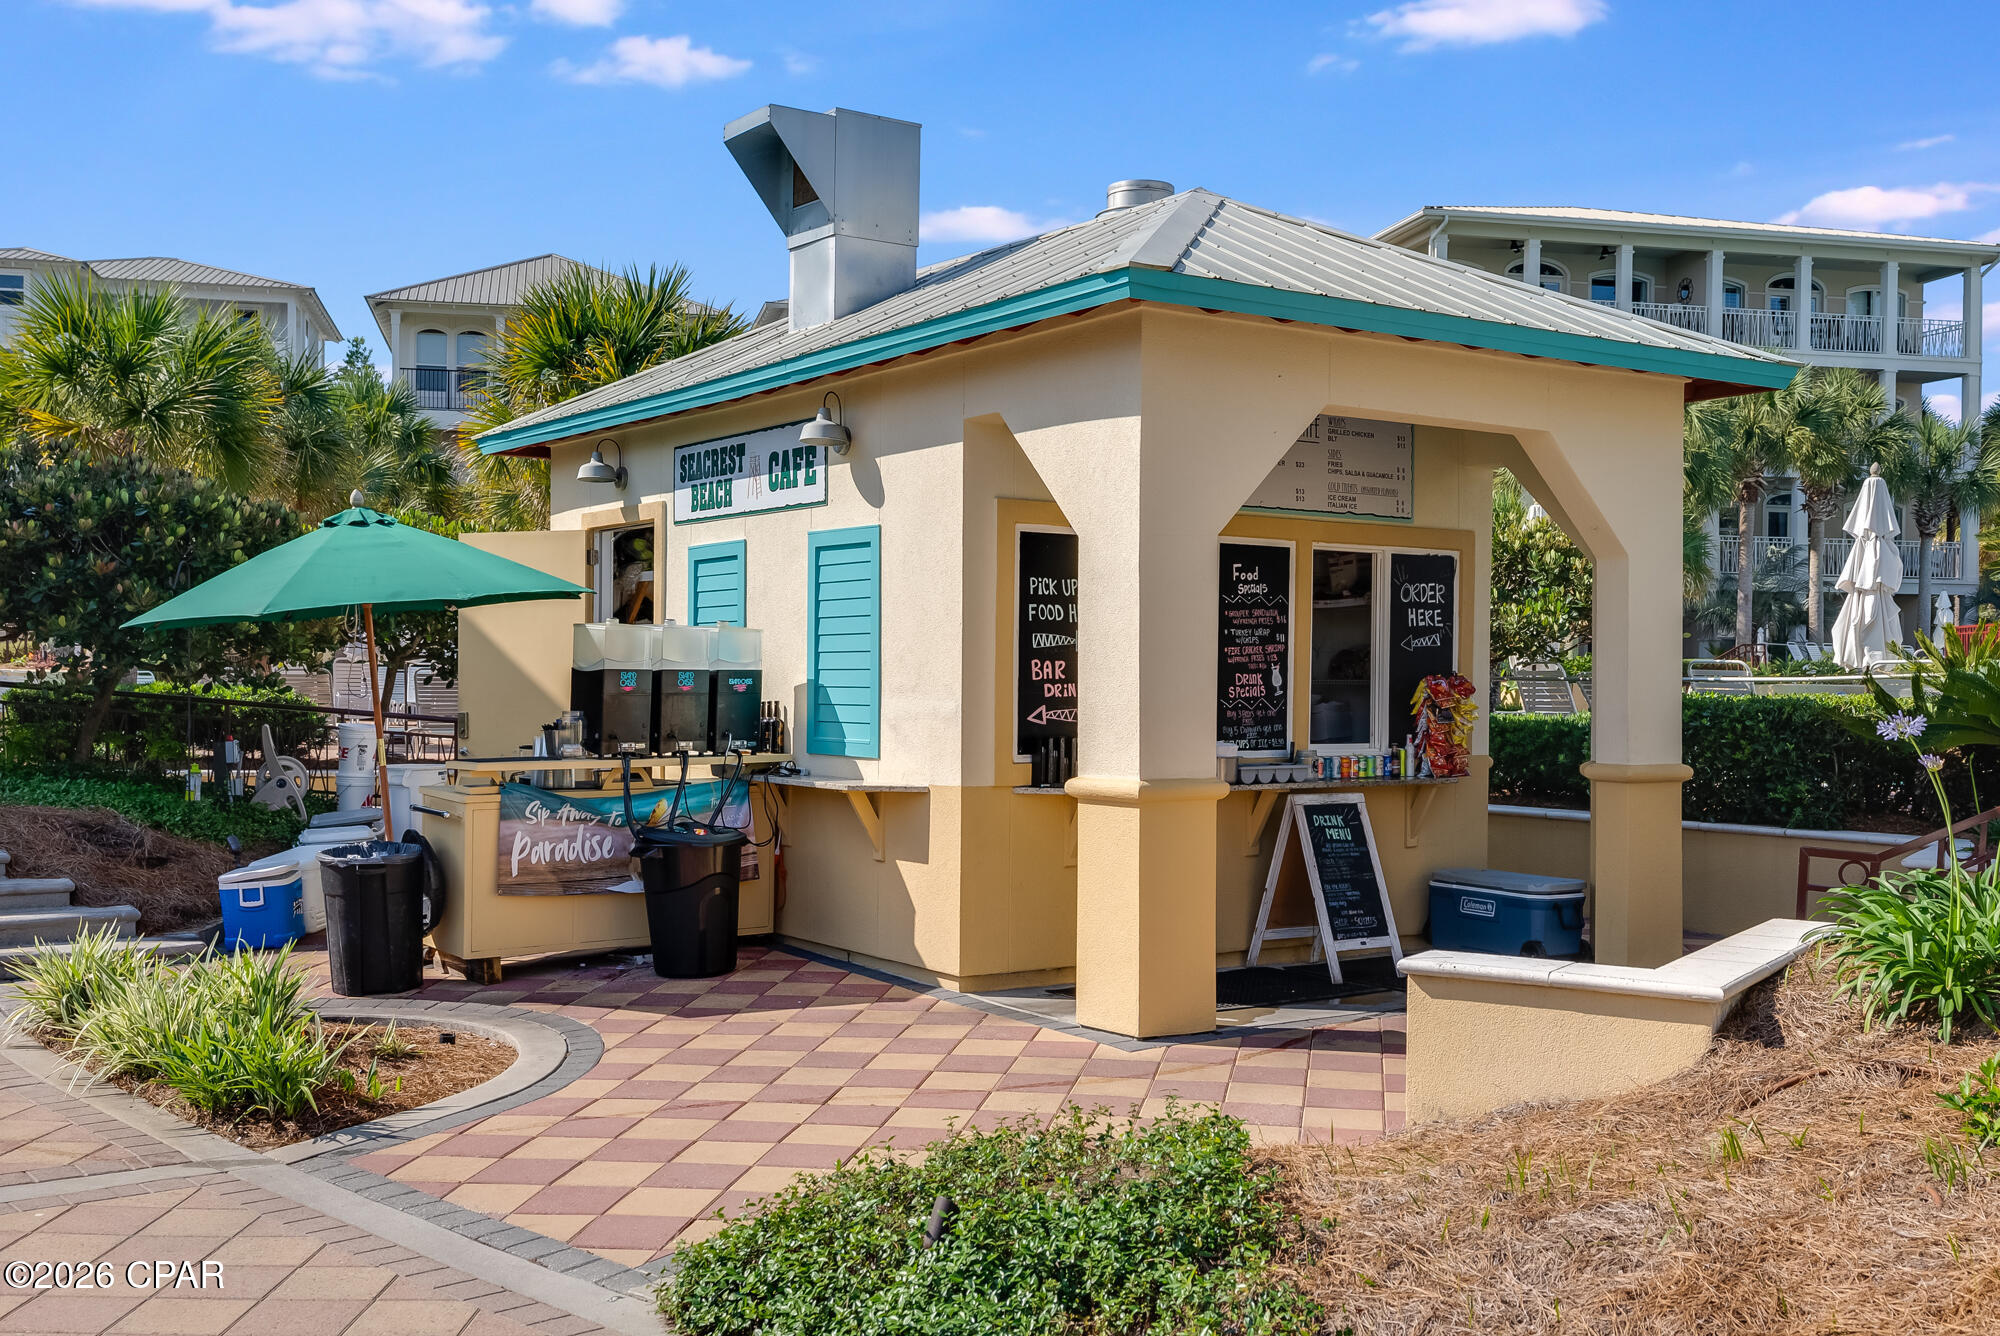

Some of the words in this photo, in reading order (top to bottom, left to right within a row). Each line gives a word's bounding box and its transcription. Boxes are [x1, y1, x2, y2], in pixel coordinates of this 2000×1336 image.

[1328, 428, 1350, 436] GRILLED
[1351, 430, 1374, 439] CHICKEN
[680, 442, 746, 483] SEACREST
[768, 446, 817, 492] CAFE
[691, 478, 732, 512] BEACH
[1232, 564, 1258, 581] Food
[1062, 578, 1078, 596] UP
[1400, 582, 1445, 604] ORDER
[1028, 604, 1064, 621] FOOD
[1408, 608, 1444, 627] HERE
[1254, 628, 1270, 636] WRAP
[1031, 659, 1066, 680] BAR
[525, 800, 550, 825] Sip
[556, 802, 602, 826] Away
[1313, 814, 1345, 828] DRINK
[1325, 828, 1352, 841] MENU
[510, 824, 616, 878] Paradise
[1464, 899, 1487, 910] Coleman
